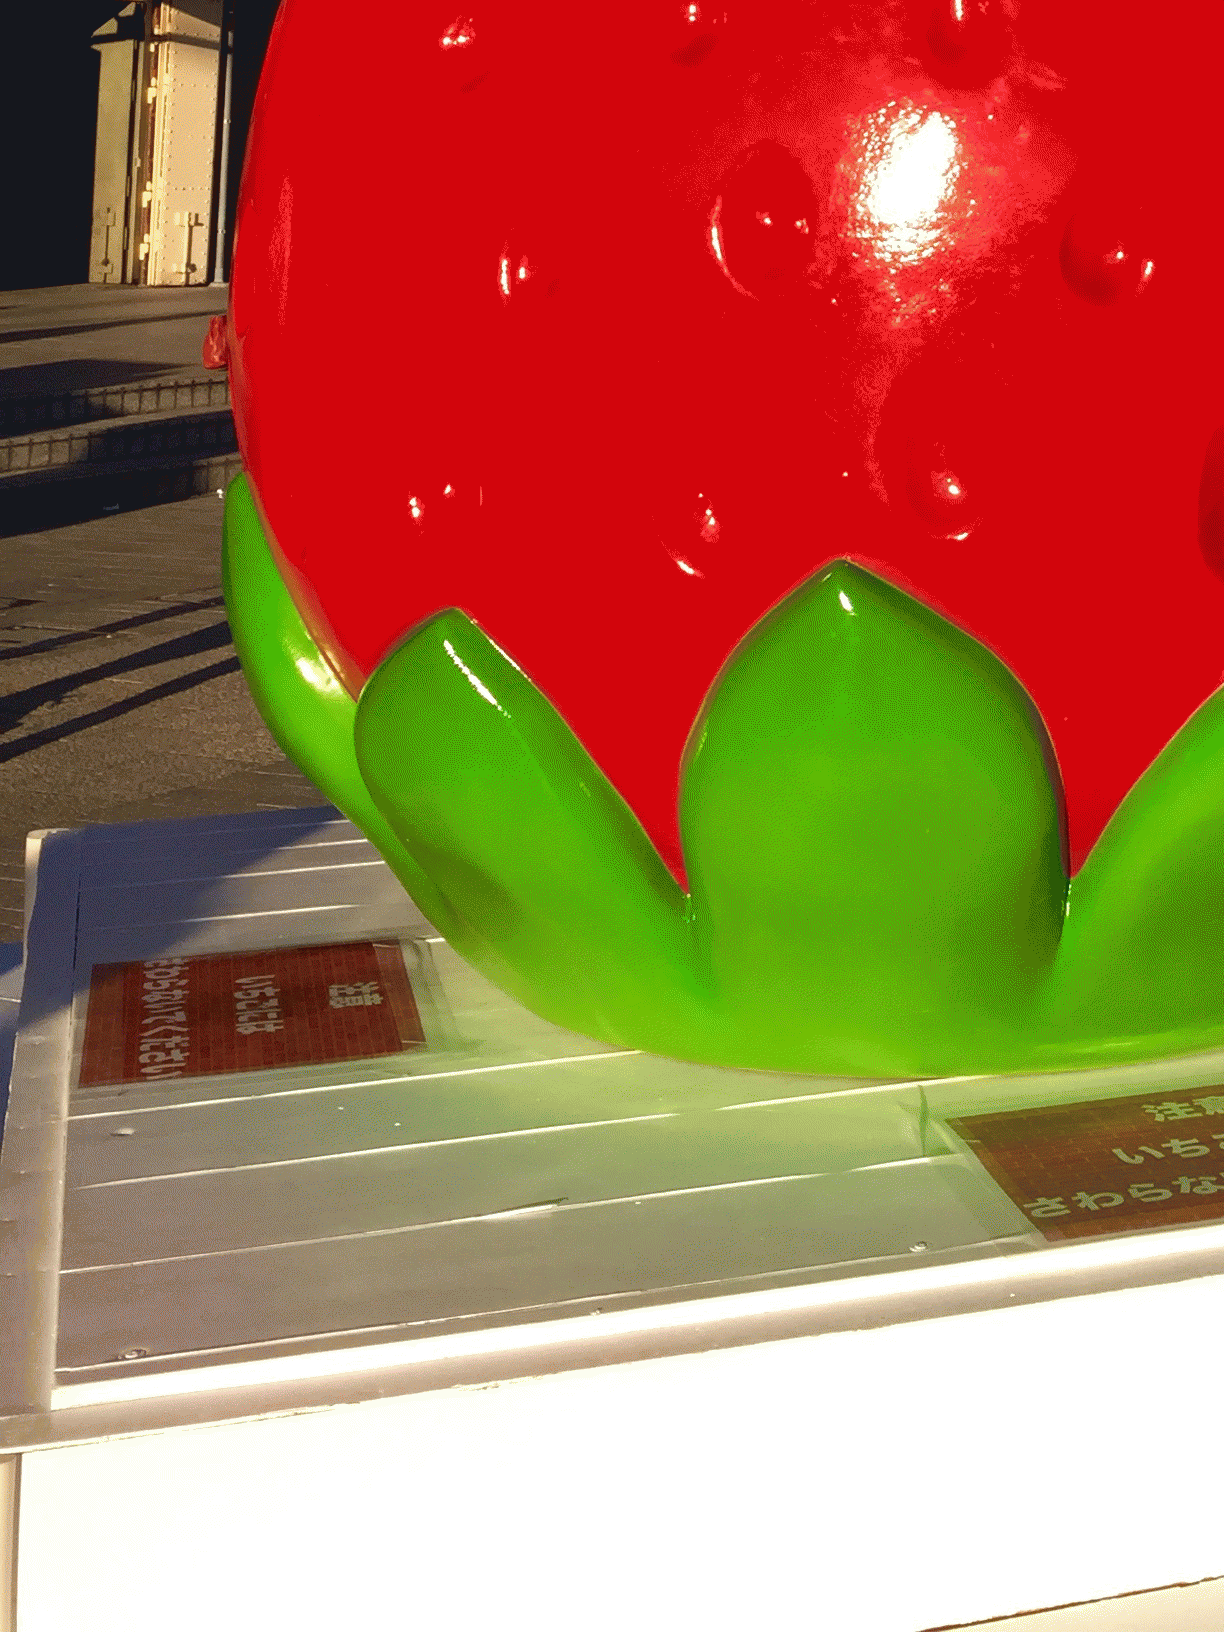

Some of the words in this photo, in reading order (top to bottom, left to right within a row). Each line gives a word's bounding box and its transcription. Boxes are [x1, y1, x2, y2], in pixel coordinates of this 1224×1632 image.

[138, 958, 190, 1080] さわらないでください
[233, 973, 285, 1036] いちごには
[329, 981, 384, 1009] 注意
